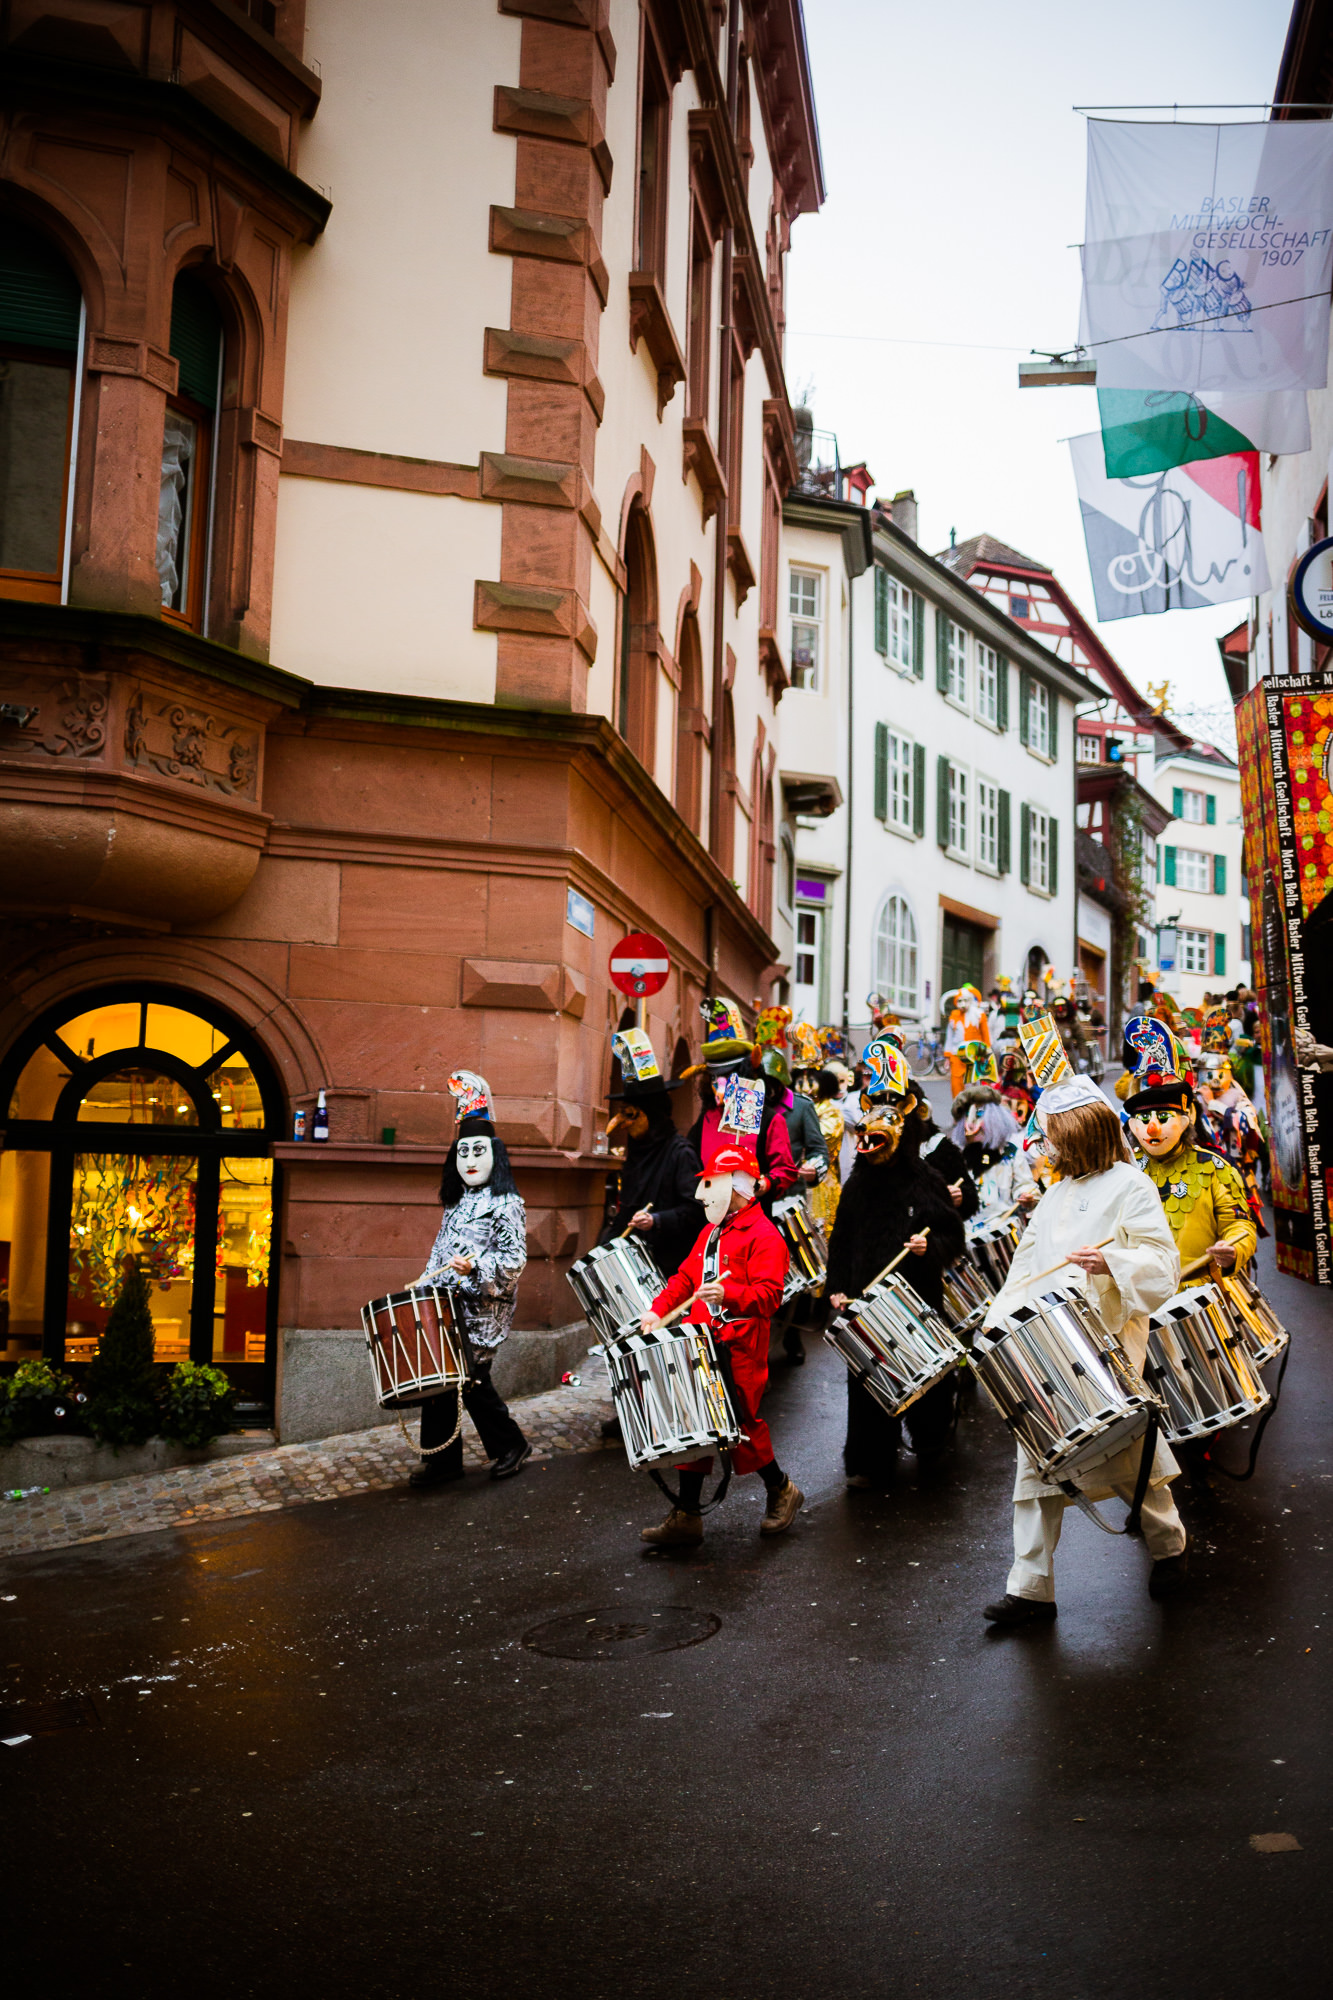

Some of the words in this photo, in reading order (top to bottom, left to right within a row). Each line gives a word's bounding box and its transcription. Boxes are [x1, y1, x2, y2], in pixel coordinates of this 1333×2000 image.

[1200, 196, 1271, 213] BASLER
[1169, 213, 1284, 231] MITTWOCH-
[1192, 228, 1332, 249] GESELLSCHAFT
[1261, 249, 1305, 267] 1907
[1266, 695, 1281, 726] Basler
[1270, 729, 1287, 779] Mittwuch
[1275, 781, 1292, 838] Gsellschaft
[1281, 849, 1296, 880] Morta
[1285, 882, 1299, 907] Bella
[1288, 918, 1302, 950] Basler
[1291, 953, 1308, 1003] Mittwuch
[1296, 1005, 1311, 1030] Gsell
[1301, 1074, 1316, 1106] Morta
[1304, 1108, 1319, 1133] Bella
[1307, 1144, 1322, 1176] Basler
[1311, 1179, 1327, 1230] Mittwuch
